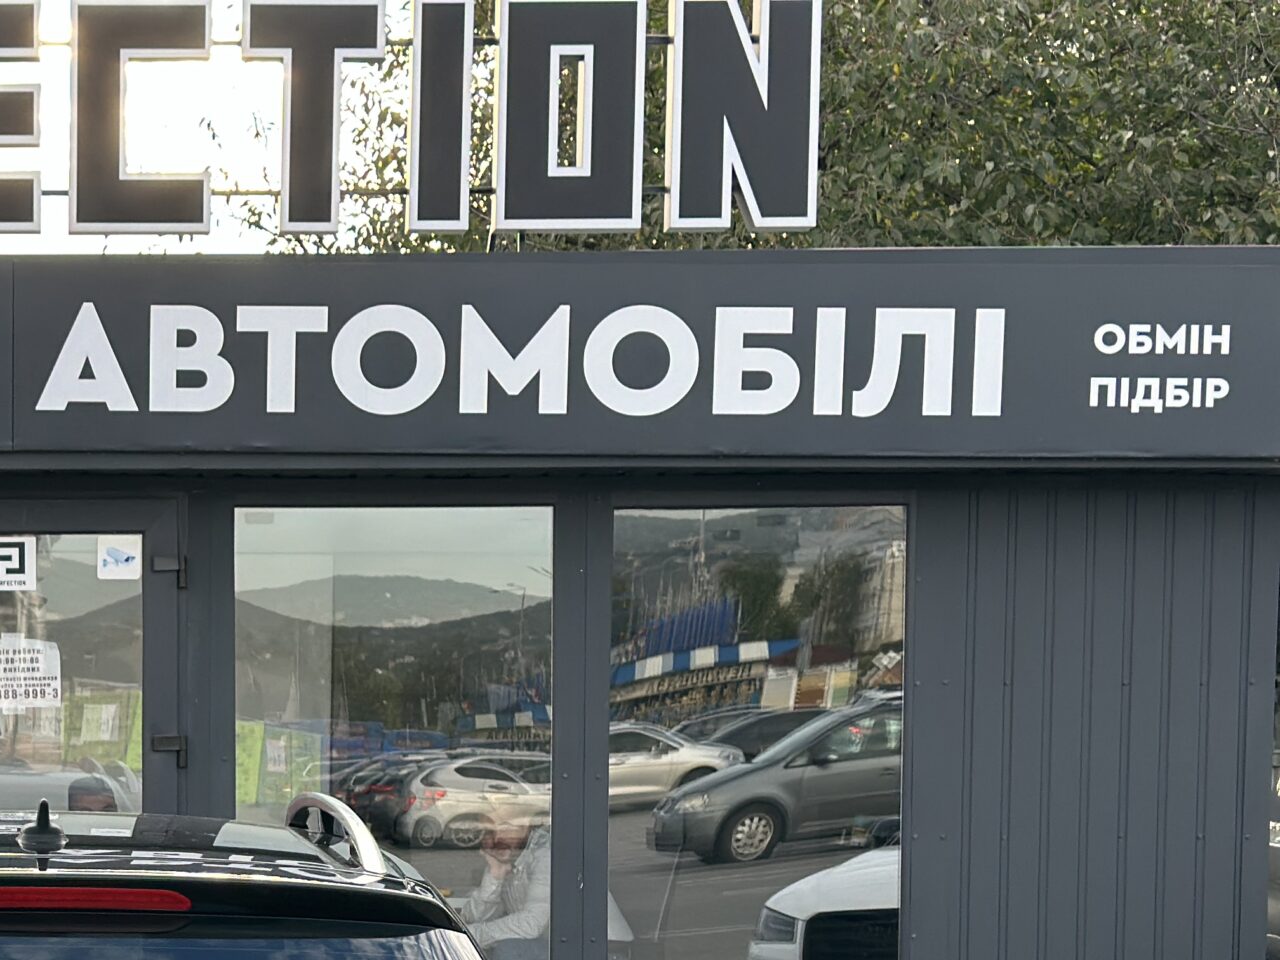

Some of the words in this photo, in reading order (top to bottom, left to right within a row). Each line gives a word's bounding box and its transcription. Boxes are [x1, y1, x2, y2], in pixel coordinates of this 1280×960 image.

[1093, 322, 1232, 356] ОБМІН
[35, 302, 1006, 418] АВТОМОБІЛІ
[1088, 376, 1231, 414] ПІДБІР
